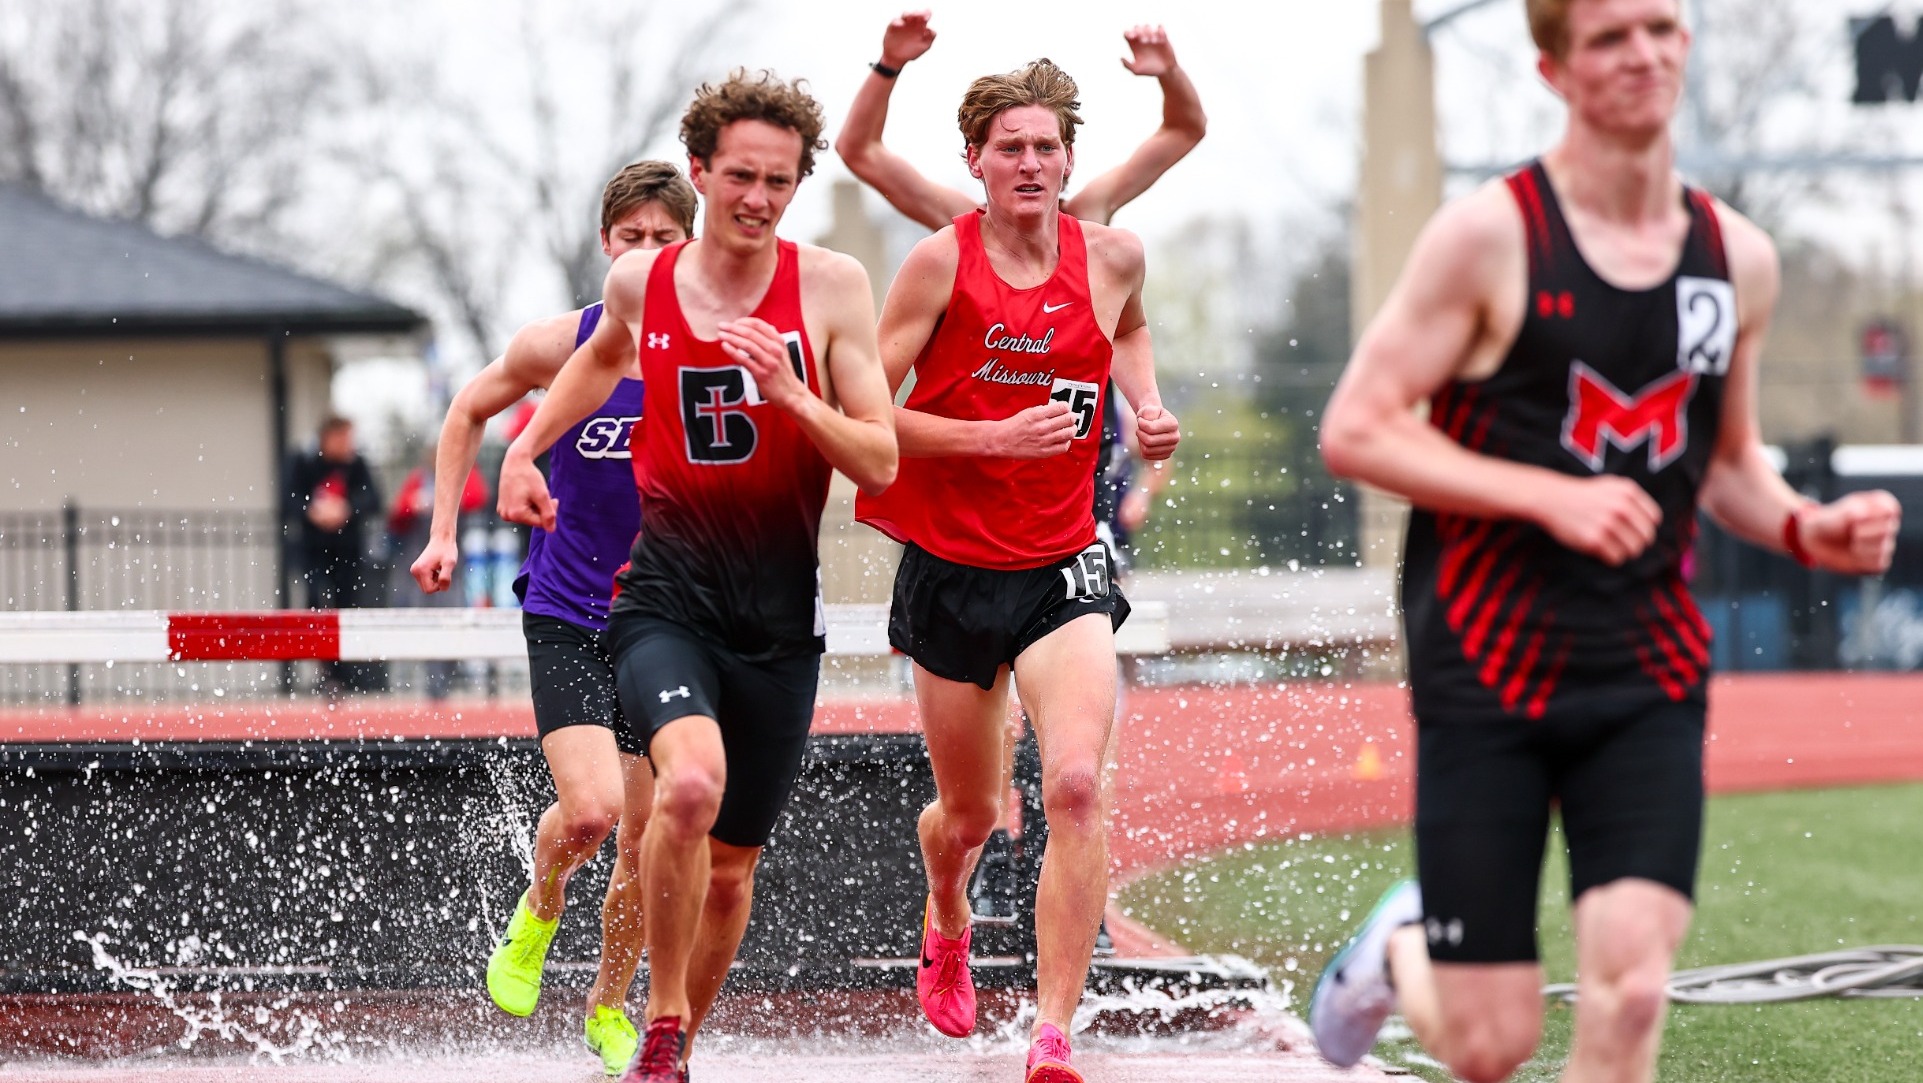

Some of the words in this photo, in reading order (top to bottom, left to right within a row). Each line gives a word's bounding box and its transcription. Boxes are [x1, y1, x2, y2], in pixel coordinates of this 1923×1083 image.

[984, 322, 1055, 354] Central
[1688, 291, 1721, 364] 2
[971, 358, 1055, 386] Missouri
[677, 364, 759, 465] B
[1560, 358, 1700, 475] M
[1070, 551, 1108, 598] 15
